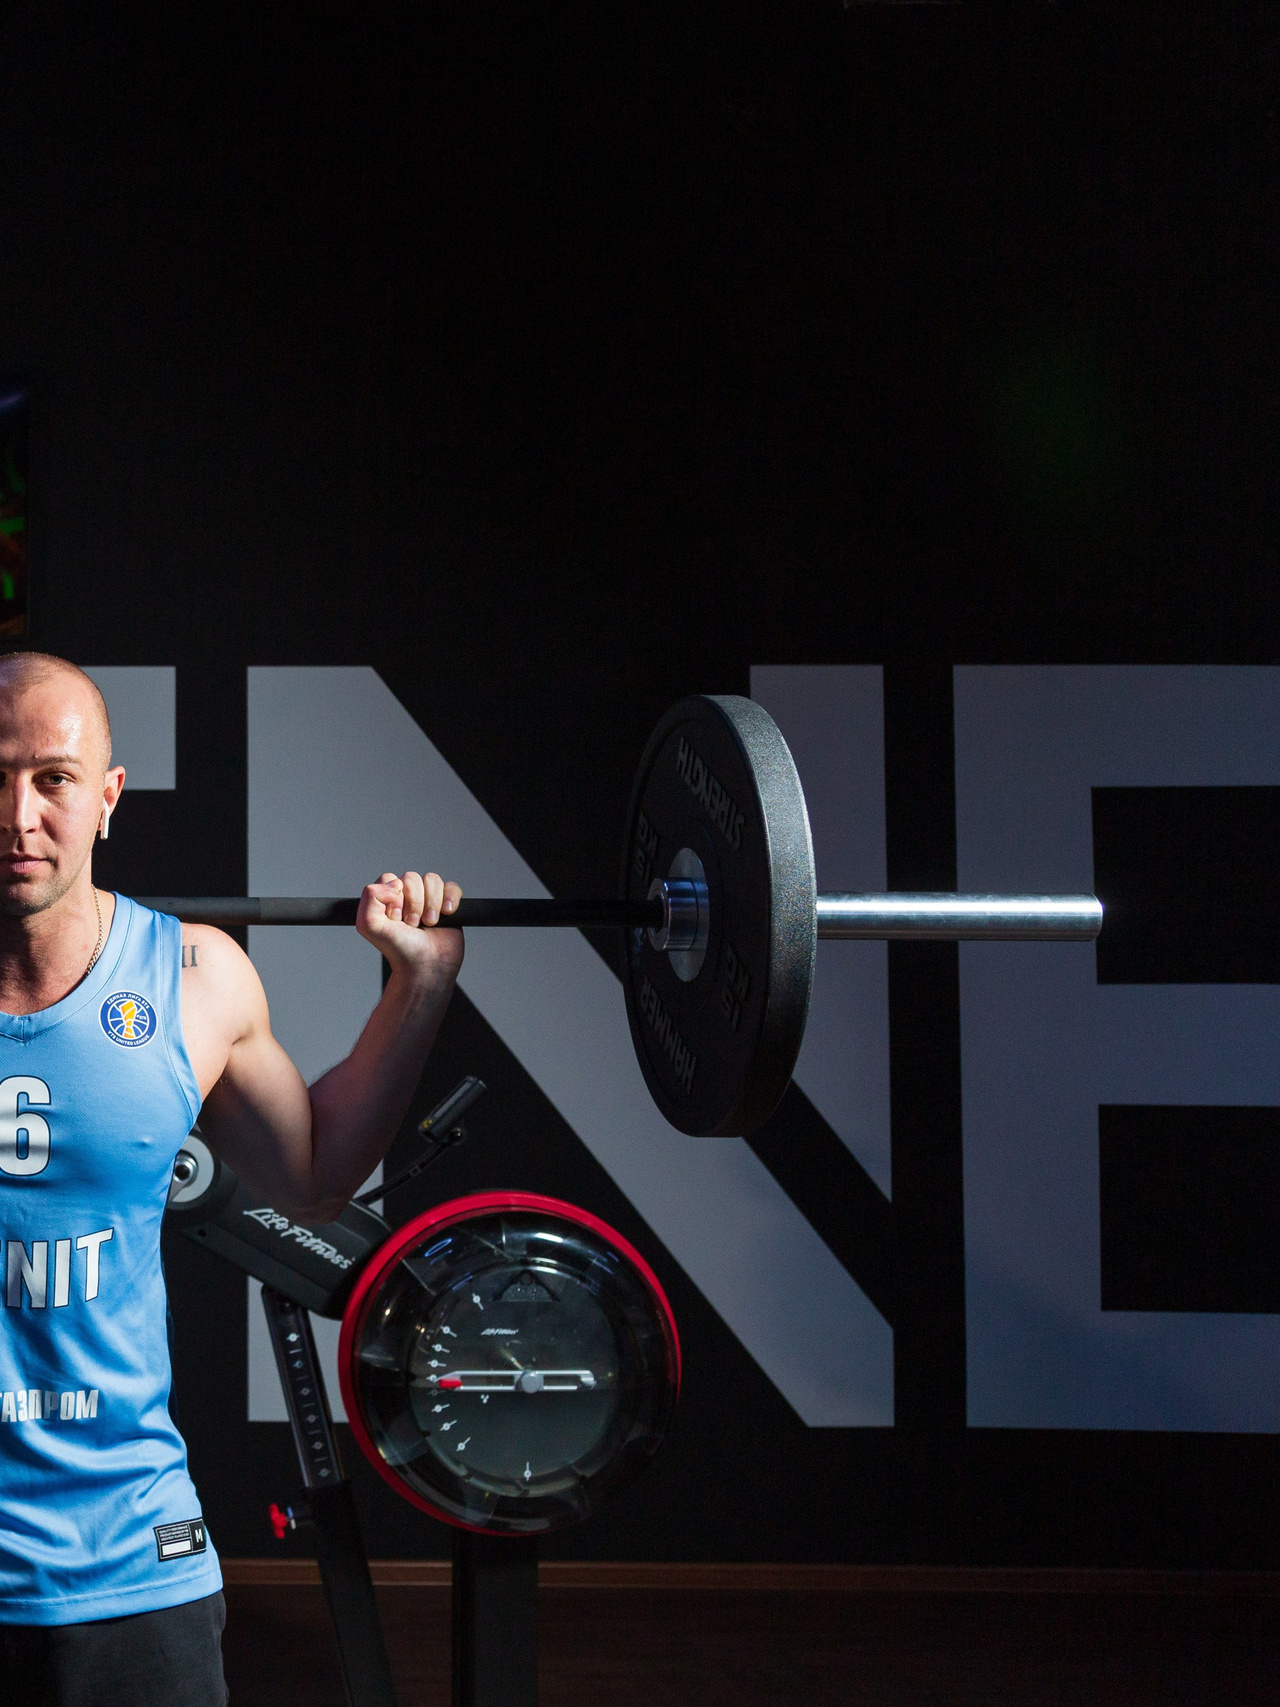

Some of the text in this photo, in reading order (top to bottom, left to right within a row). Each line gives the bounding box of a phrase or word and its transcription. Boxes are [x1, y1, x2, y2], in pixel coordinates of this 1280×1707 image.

[677, 735, 745, 852] STRENGTH
[639, 974, 698, 1095] HAMMER
[242, 1207, 353, 1270] Life Fitness
[195, 1529, 203, 1543] M
